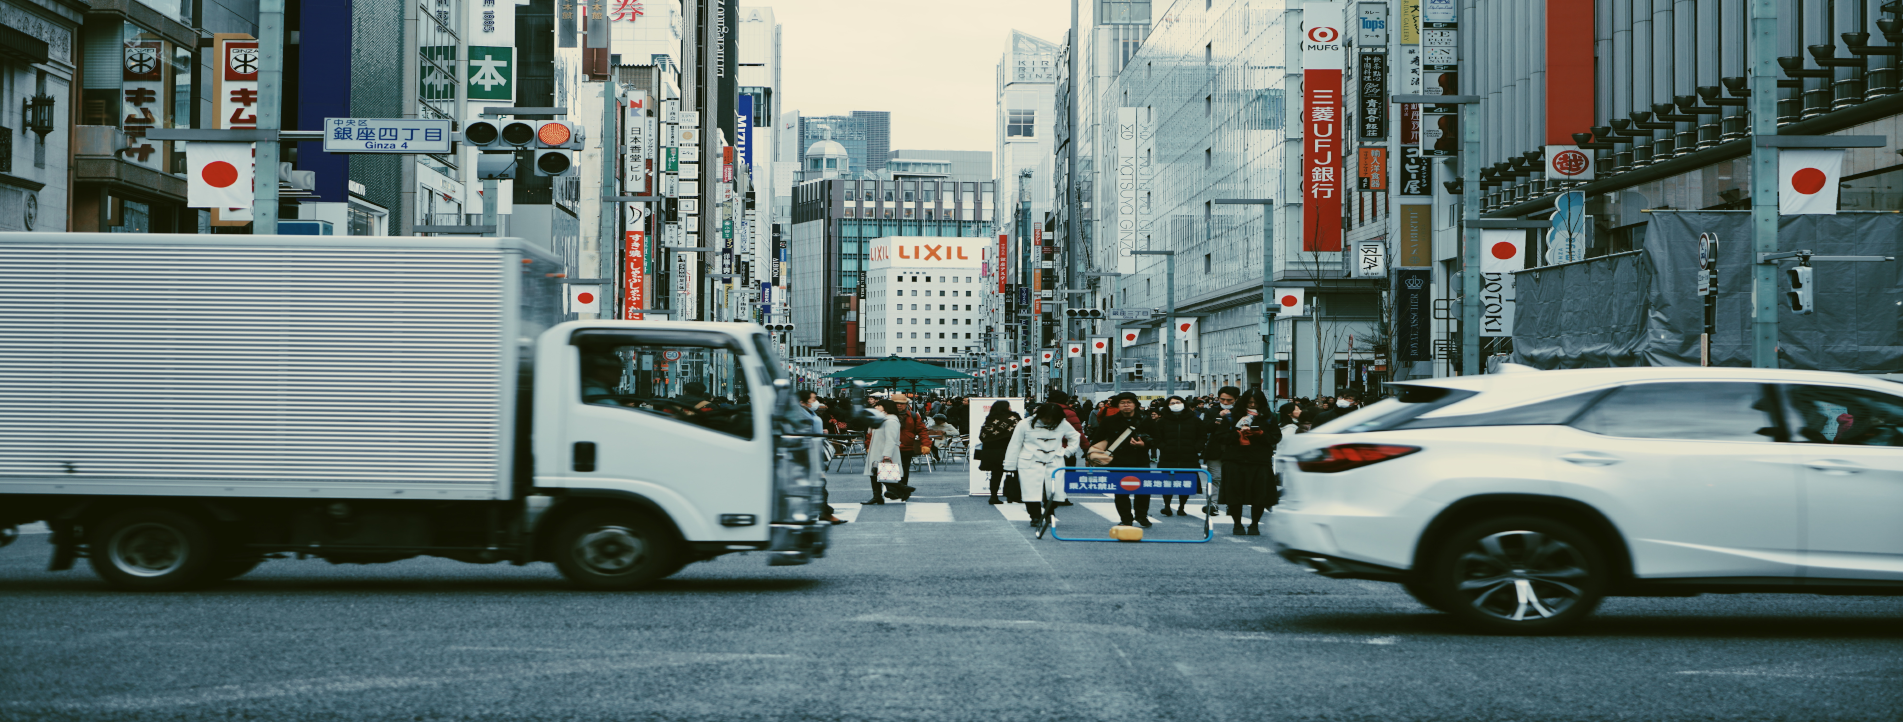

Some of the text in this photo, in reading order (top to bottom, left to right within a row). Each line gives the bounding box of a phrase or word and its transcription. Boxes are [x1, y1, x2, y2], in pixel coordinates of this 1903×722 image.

[469, 55, 508, 91] 本
[333, 119, 368, 127] 中央区
[333, 127, 442, 141] 銀座四丁目
[364, 141, 396, 149] Ginza
[1311, 89, 1334, 199] 三菱UFJ銀行
[630, 127, 642, 182] 日本香堂ビル
[1371, 149, 1380, 188] 輸入洋食器
[870, 246, 889, 262] LIXIL
[899, 244, 968, 261] LIXIL
[1410, 331, 1418, 356] ROYAL
[1069, 482, 1117, 490] 乗入れ禁止
